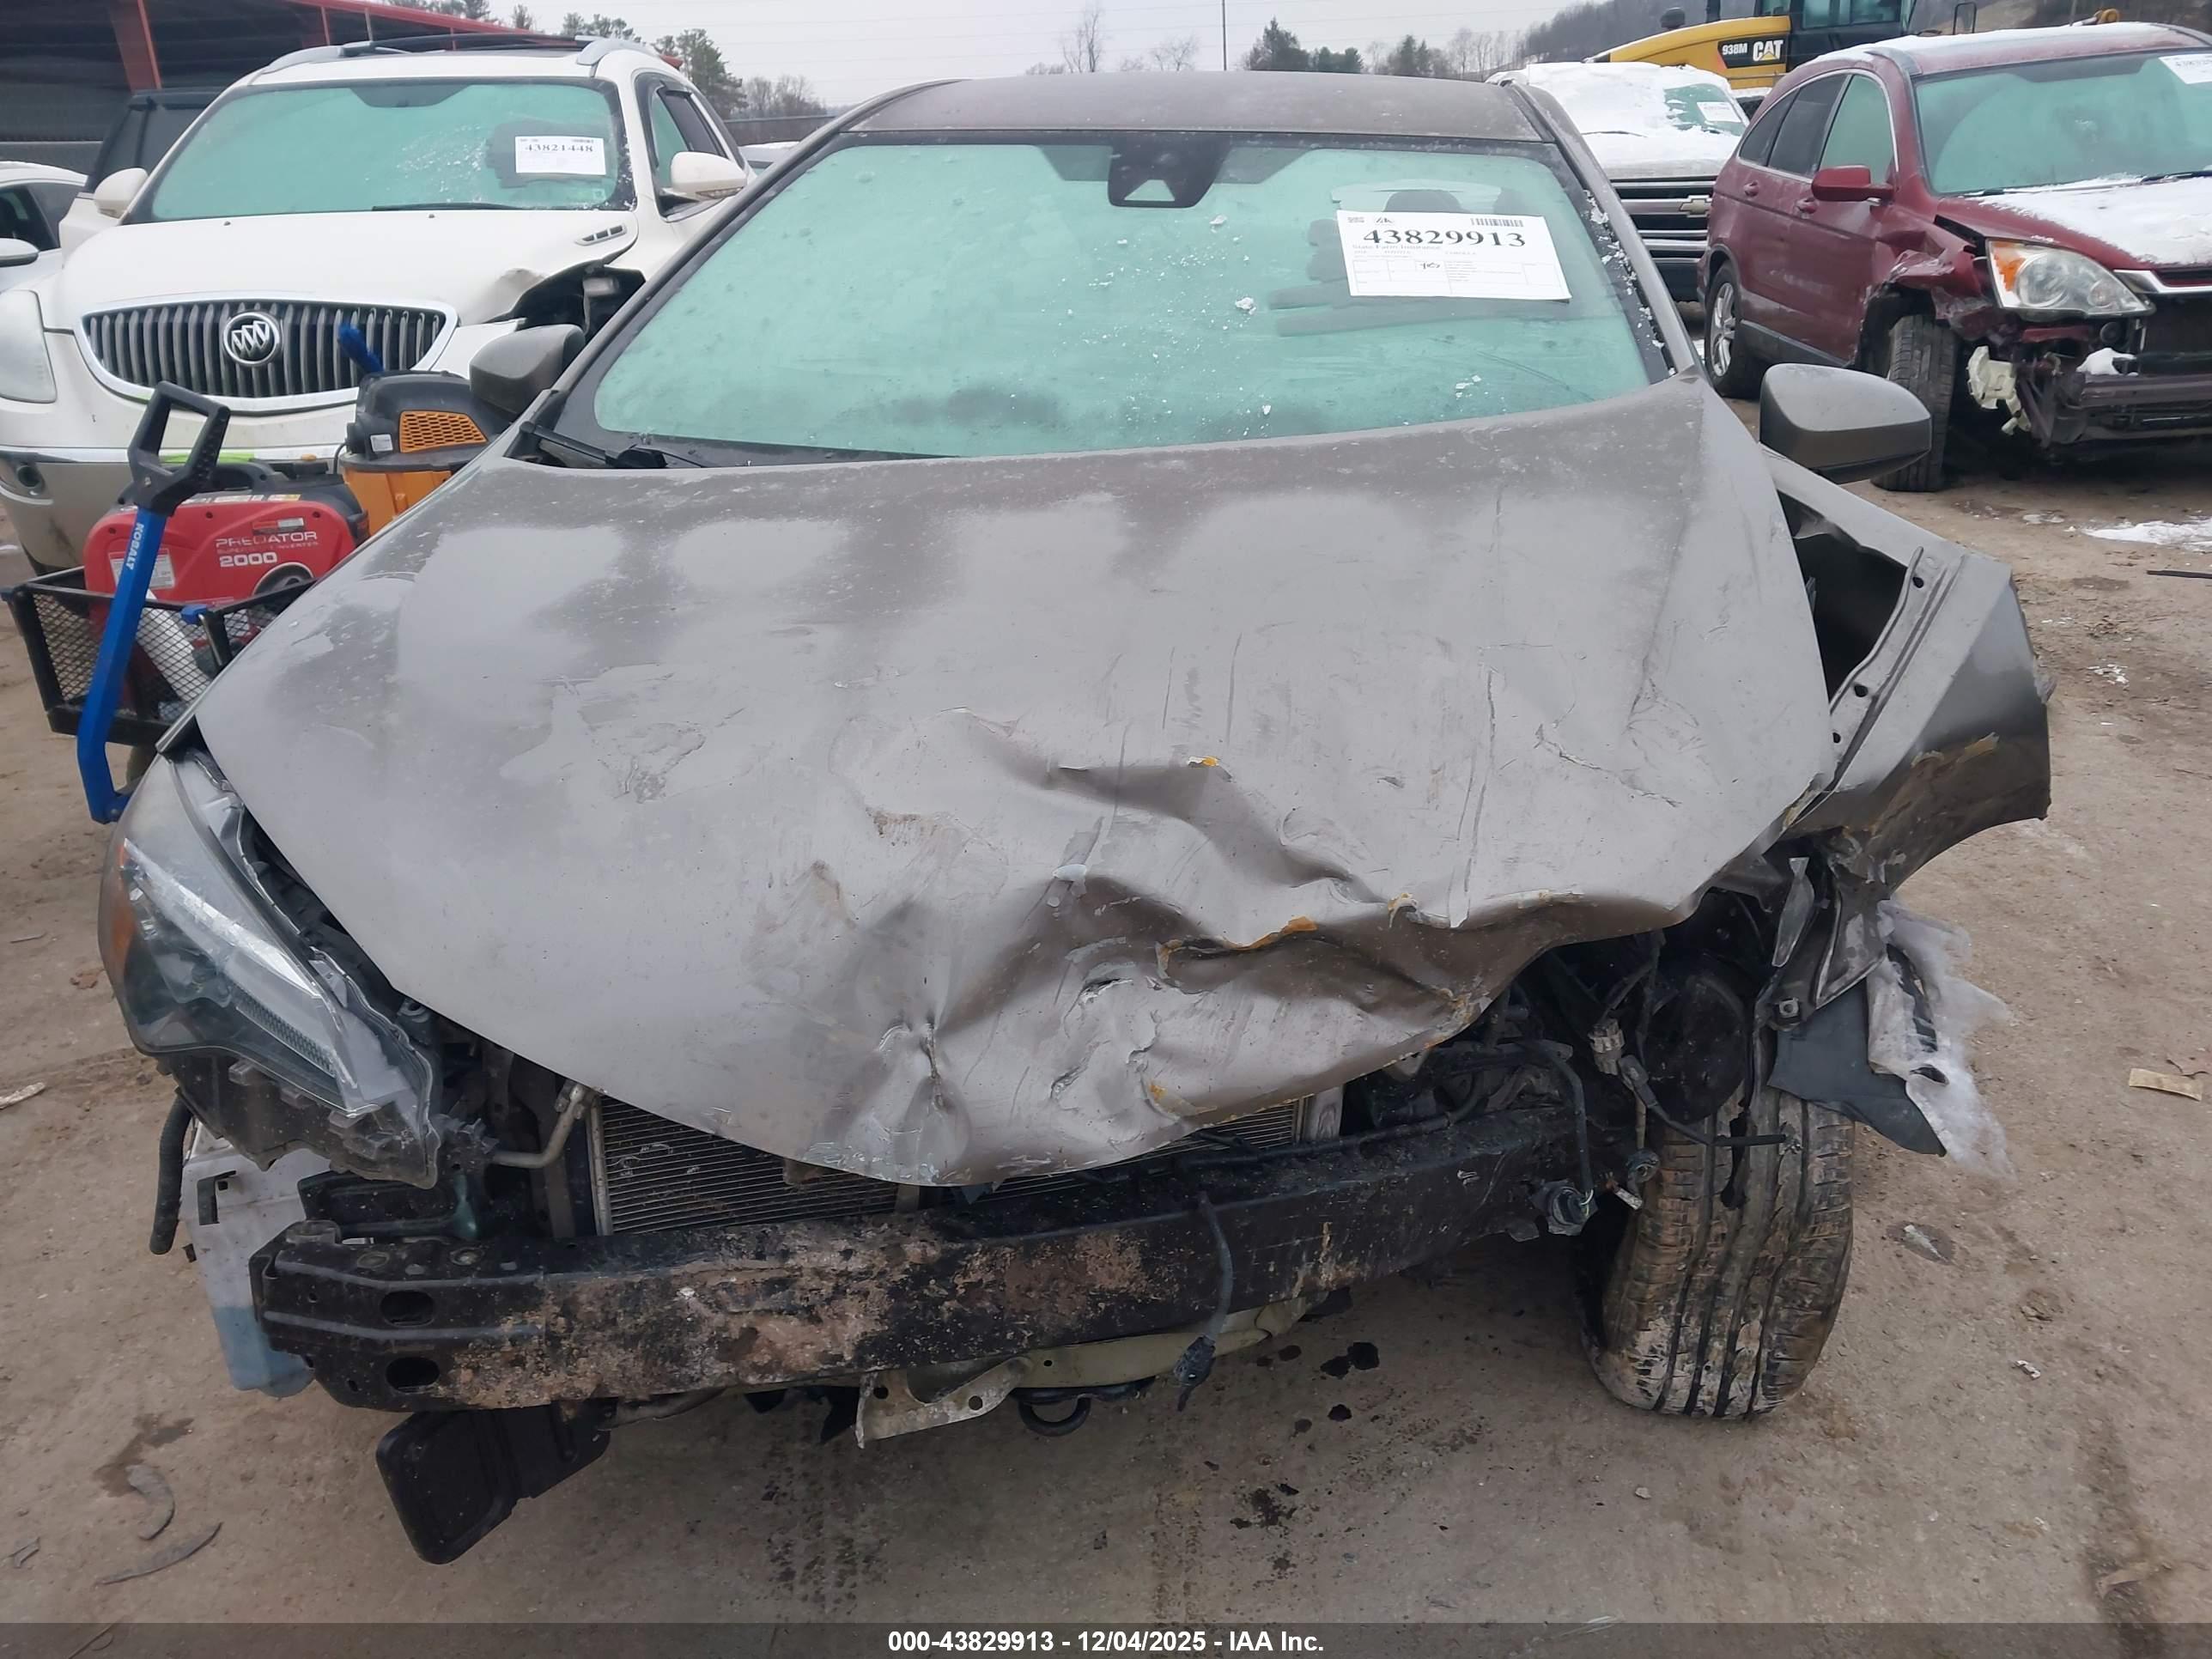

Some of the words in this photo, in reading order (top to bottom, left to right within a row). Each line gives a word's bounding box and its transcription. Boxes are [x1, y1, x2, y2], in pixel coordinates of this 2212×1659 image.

[1723, 43, 1748, 56] 938M
[1753, 40, 1784, 61] CAT
[525, 143, 593, 152] 43821448
[1363, 229, 1526, 247] 43829913
[125, 522, 144, 570] KOBALT
[215, 531, 318, 548] PREDATOR
[219, 551, 277, 568] 2000
